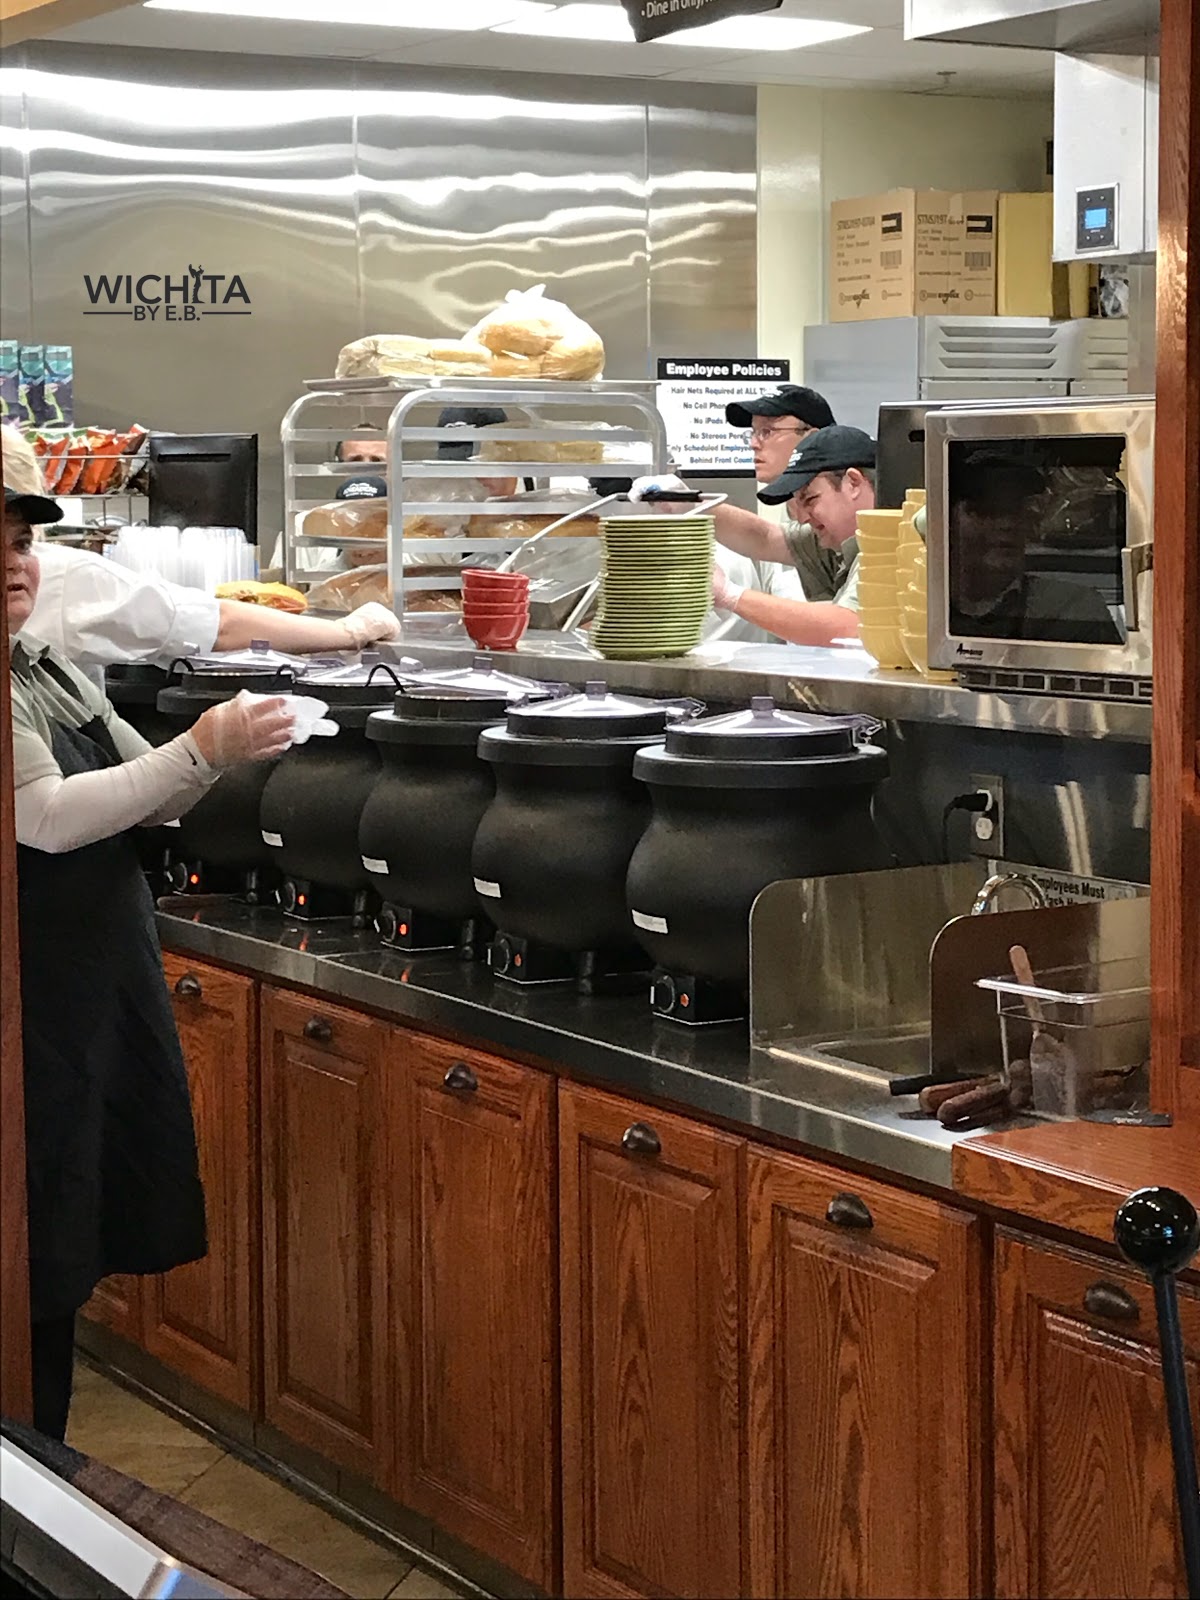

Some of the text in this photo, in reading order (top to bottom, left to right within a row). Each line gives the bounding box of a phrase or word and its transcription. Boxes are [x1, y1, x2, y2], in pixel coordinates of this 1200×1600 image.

[646, 0, 669, 18] Dine
[666, 362, 782, 377] Employee Policies
[671, 387, 686, 395] Hair
[687, 387, 703, 395] Nets
[704, 387, 735, 396] Required
[745, 387, 758, 396] ALL
[683, 402, 727, 410] No Cell Phon
[693, 416, 703, 425] No
[690, 432, 700, 440] No
[701, 432, 727, 440] Stereos
[683, 444, 719, 452] Scheduled
[690, 456, 753, 464] Behind Front Count
[1081, 882, 1105, 899] Must
